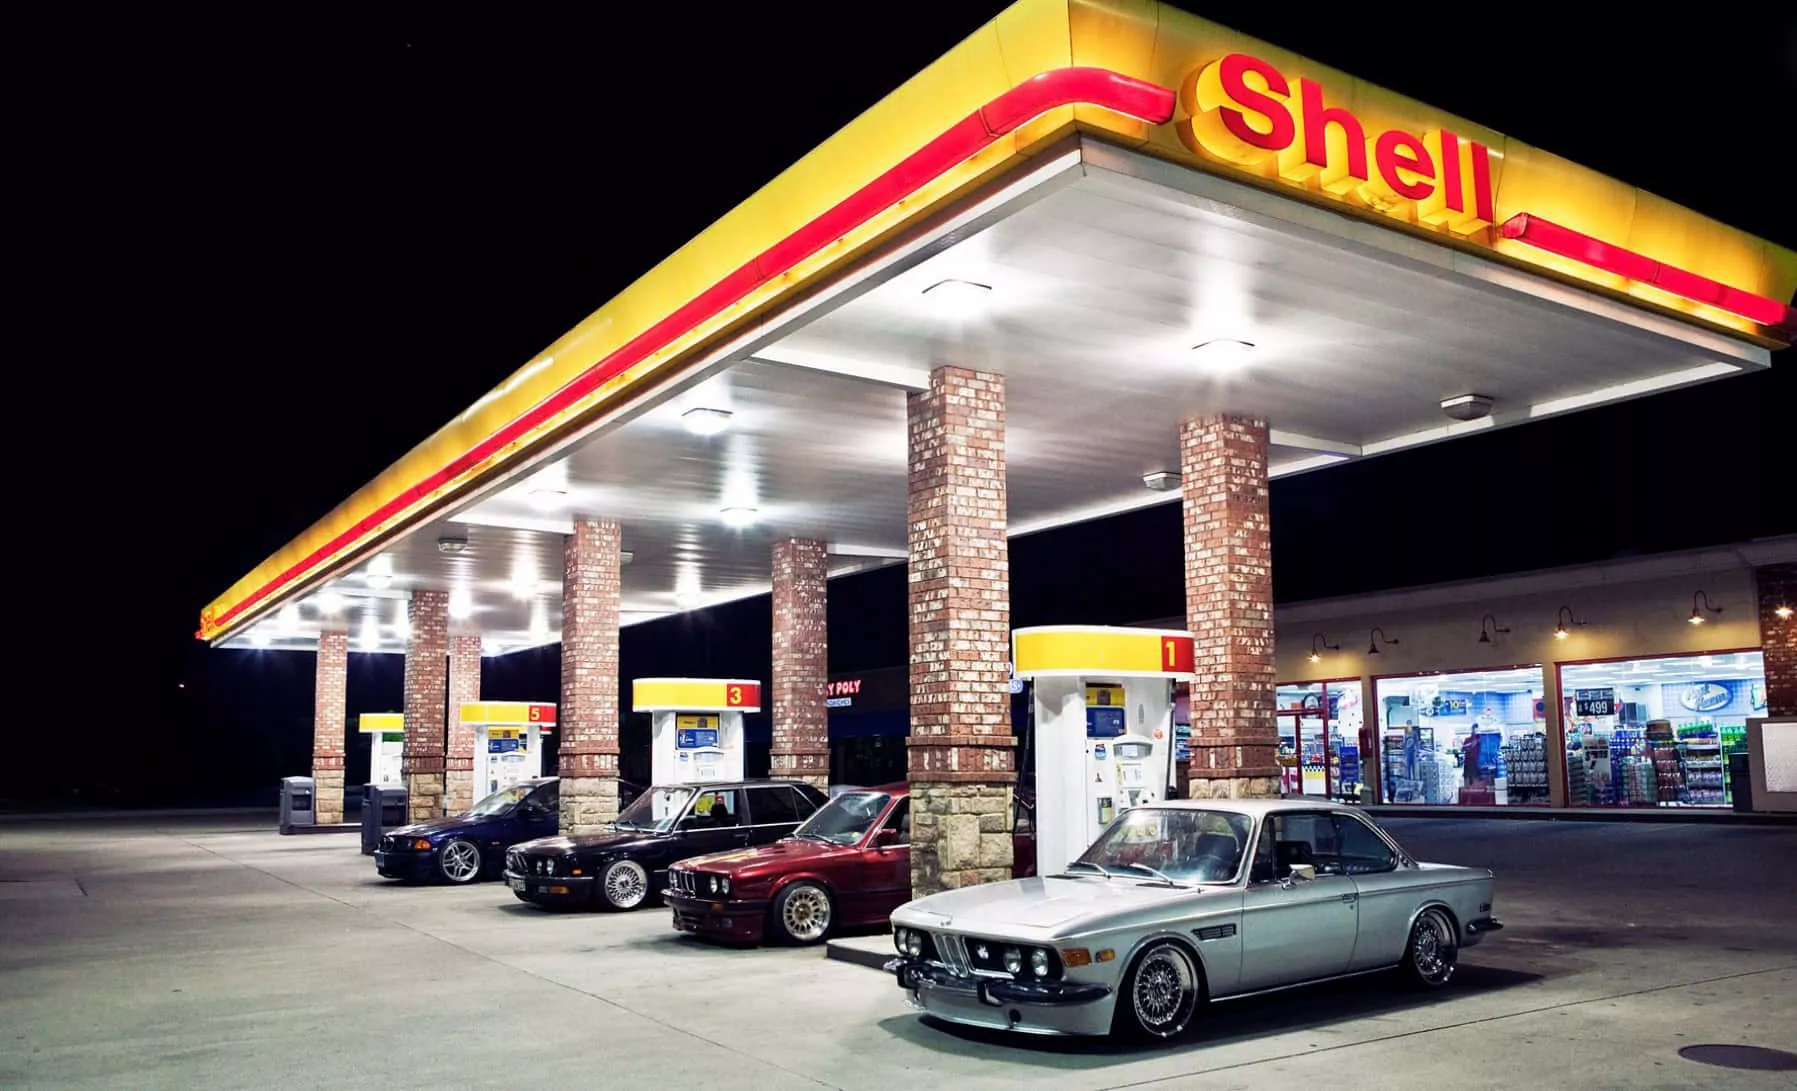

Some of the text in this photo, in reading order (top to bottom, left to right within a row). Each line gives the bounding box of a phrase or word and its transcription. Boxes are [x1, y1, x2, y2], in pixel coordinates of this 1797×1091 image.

[1219, 53, 1494, 223] Shell
[1165, 640, 1176, 667] 1
[730, 686, 743, 705] 3
[836, 679, 861, 695] POLY
[530, 707, 541, 721] 5
